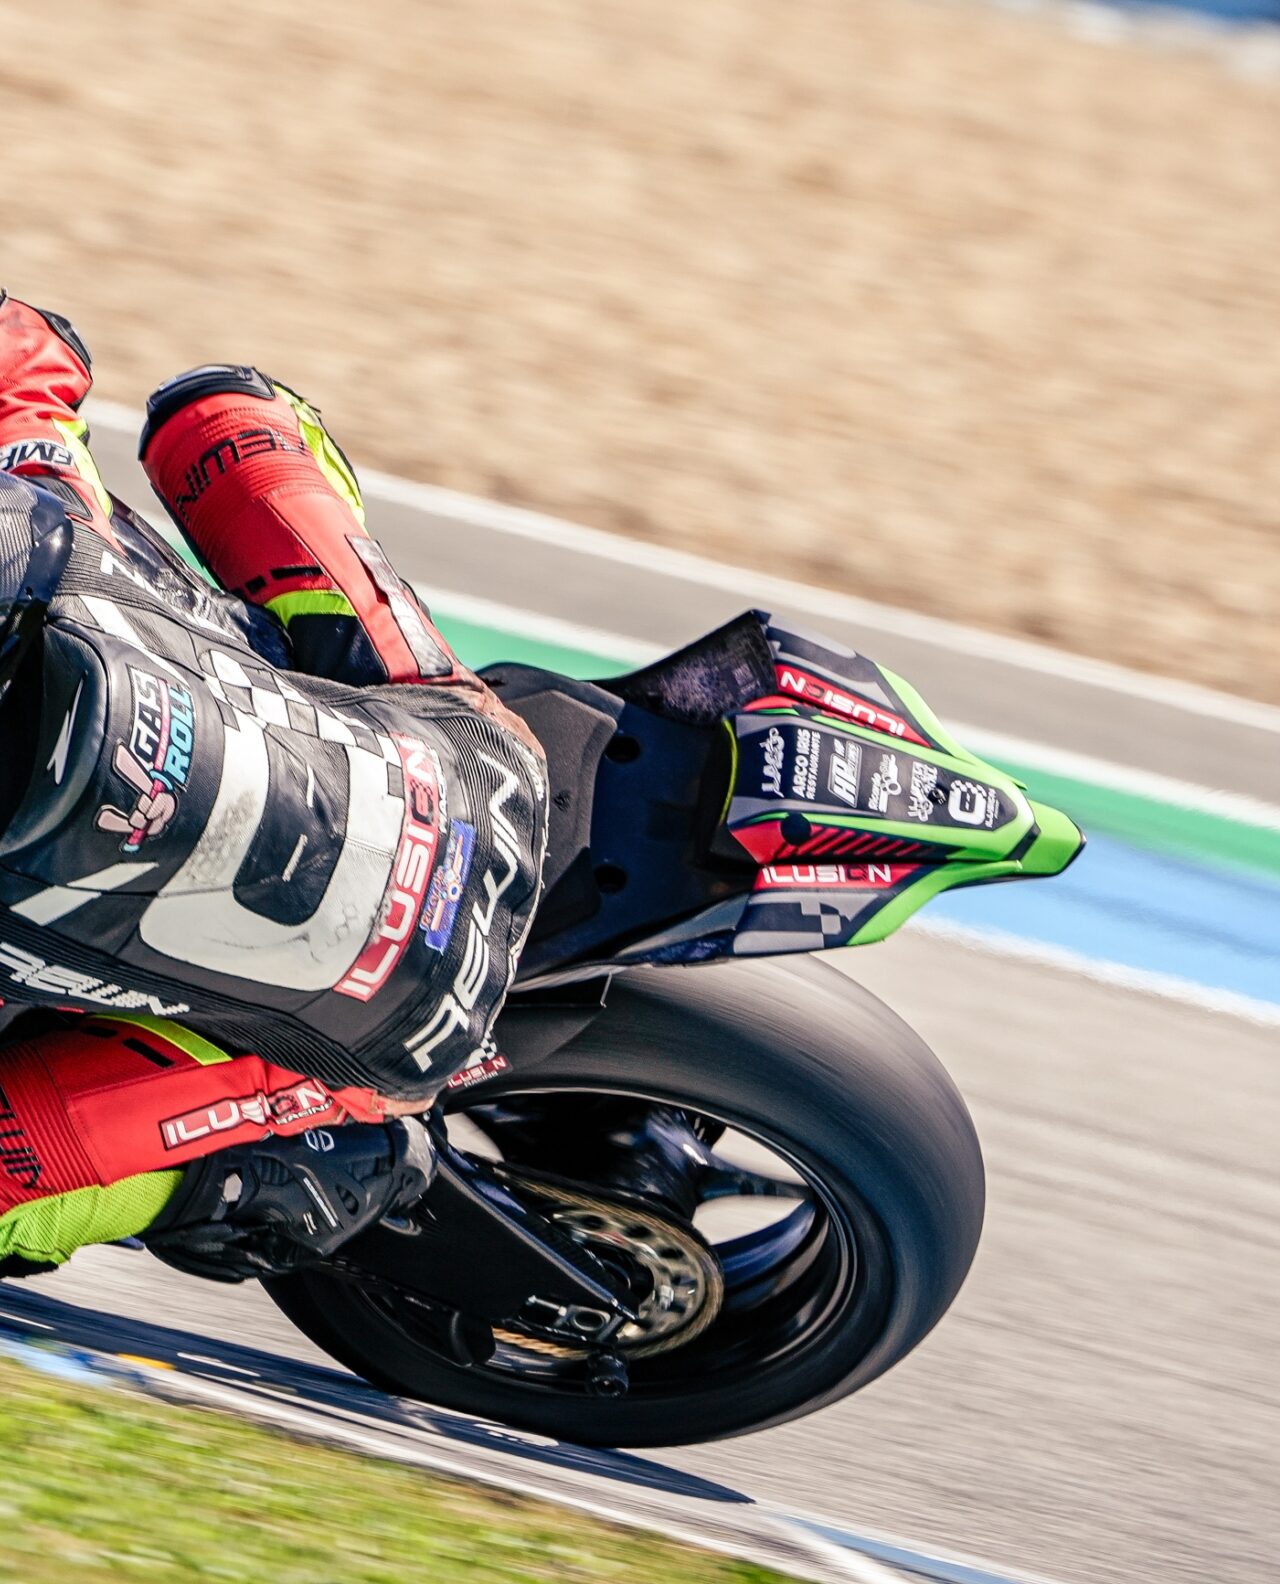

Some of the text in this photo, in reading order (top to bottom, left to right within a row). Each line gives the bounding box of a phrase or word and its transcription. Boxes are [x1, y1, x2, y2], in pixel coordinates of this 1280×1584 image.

[133, 677, 164, 763] GAS
[165, 683, 193, 785] ROLL
[792, 755, 809, 798] ARCO
[403, 748, 520, 1072] REWIN
[762, 864, 891, 883] ILUSION
